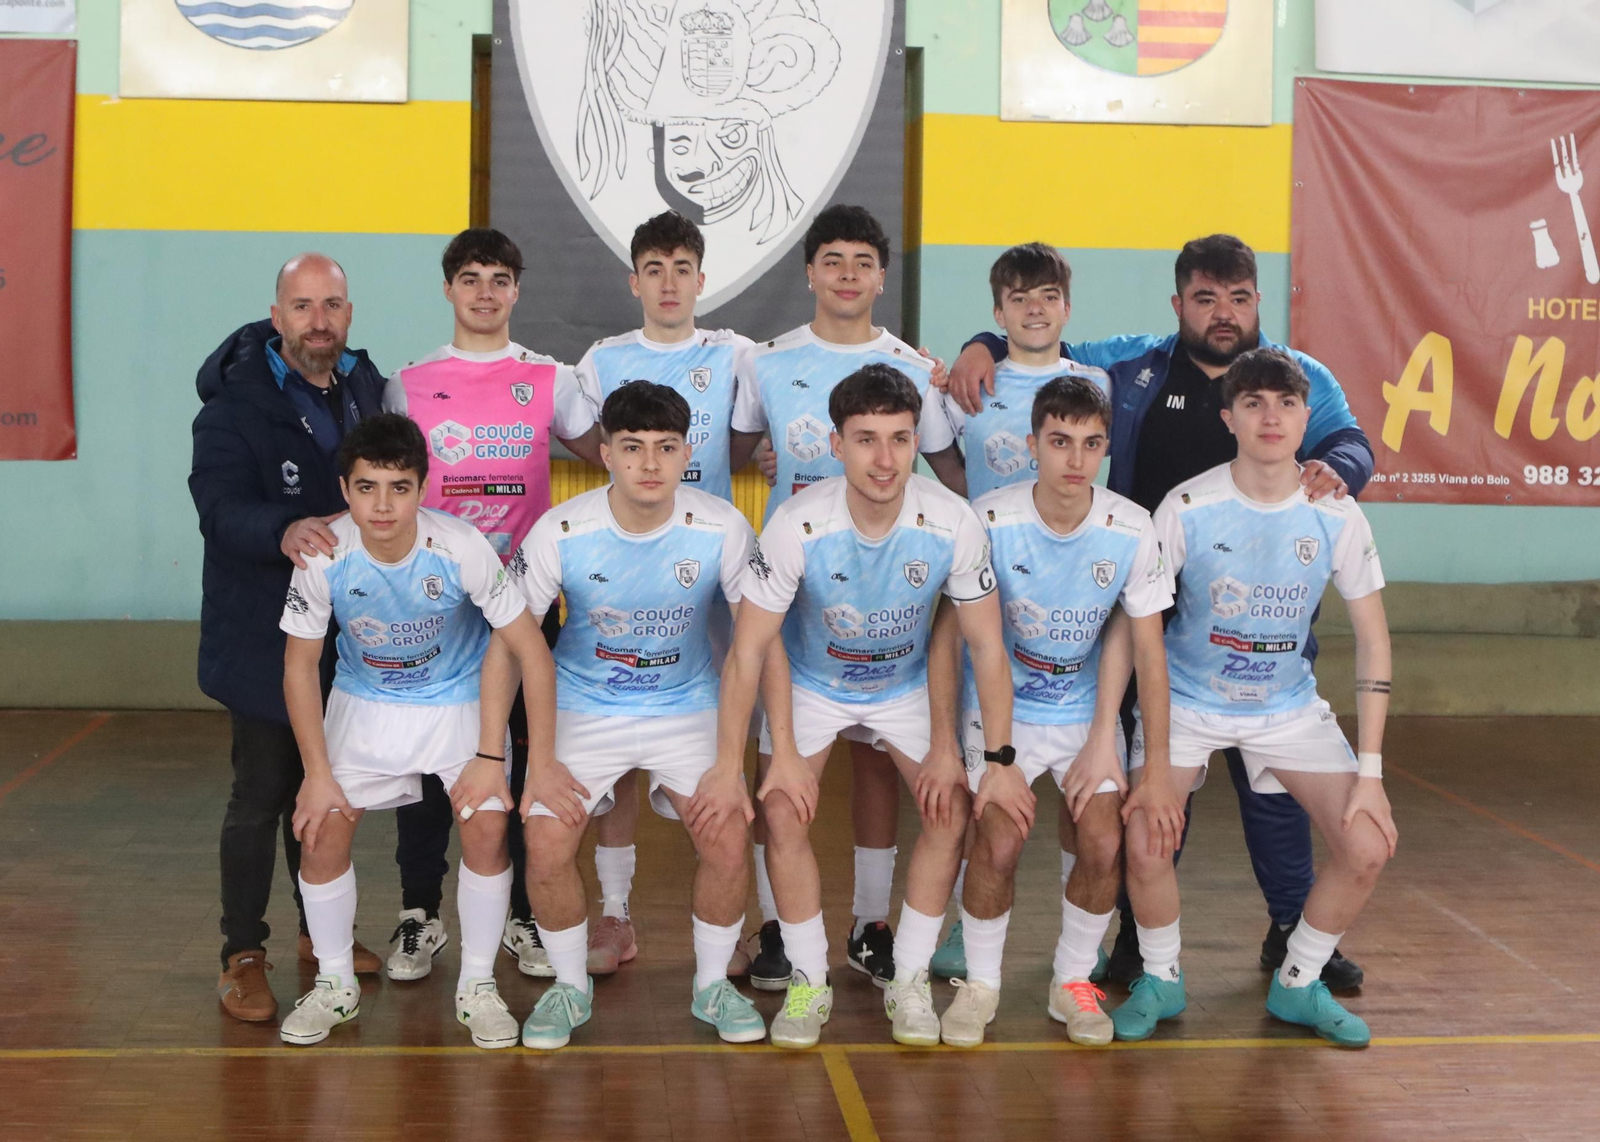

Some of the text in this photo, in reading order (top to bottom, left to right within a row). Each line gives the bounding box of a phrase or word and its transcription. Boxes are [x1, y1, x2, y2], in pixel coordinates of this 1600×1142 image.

[1528, 297, 1600, 320] HOTE
[1381, 331, 1454, 453] A
[474, 422, 534, 443] coyde
[475, 444, 532, 459] GROUP
[443, 475, 487, 483] Bricomarc
[681, 471, 699, 480] LAR
[794, 473, 829, 482] Bricom
[1402, 472, 1409, 483] 2
[1411, 472, 1436, 484] 3255
[1439, 473, 1468, 485] Viana
[1471, 474, 1485, 485] do
[1487, 474, 1510, 486] Bolo
[1523, 464, 1570, 485] 988
[496, 485, 523, 494] MILAR
[979, 567, 992, 591] C
[1253, 584, 1308, 604] coyde
[633, 606, 694, 623] coyde
[868, 605, 925, 624] coyde
[1051, 607, 1108, 627] coyde
[390, 616, 444, 634] coyde
[633, 621, 690, 637] GROUP
[1213, 625, 1257, 640] Bricomarc
[597, 642, 642, 654] Bricomarc
[885, 646, 911, 660] MILAR
[1265, 642, 1294, 651] MILAR
[415, 651, 438, 666] MILAR
[649, 655, 677, 666] MILAR
